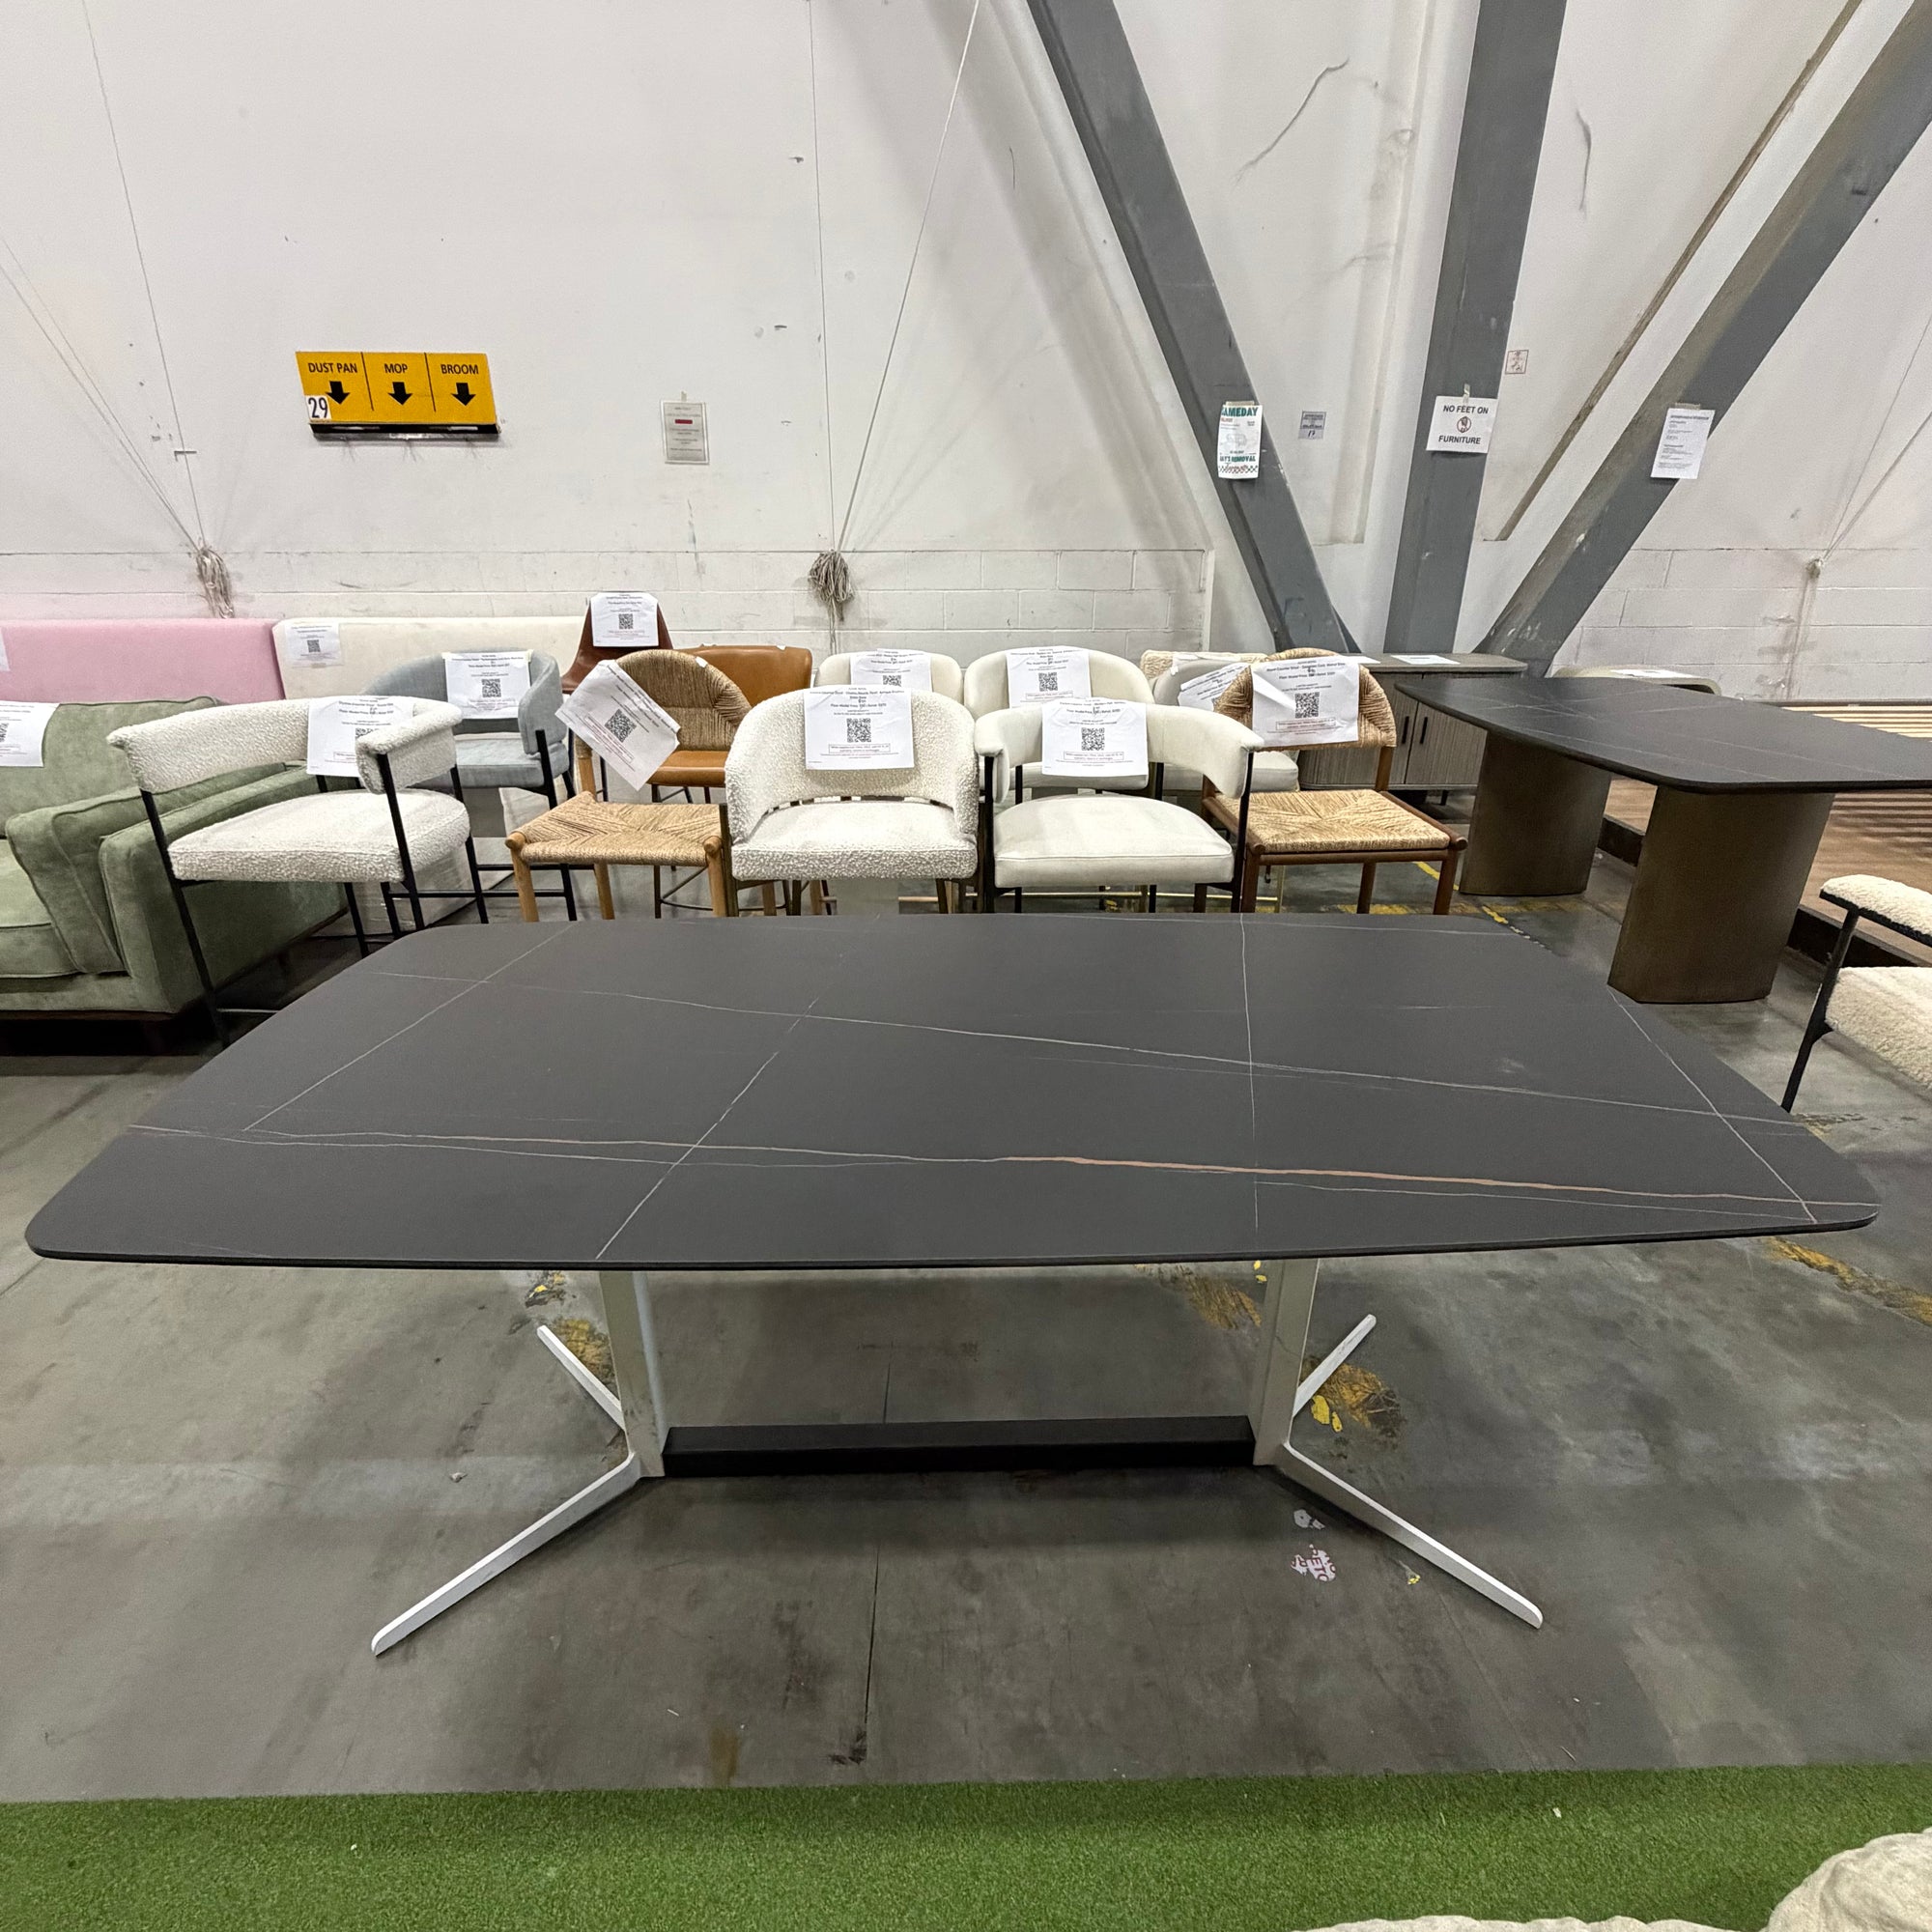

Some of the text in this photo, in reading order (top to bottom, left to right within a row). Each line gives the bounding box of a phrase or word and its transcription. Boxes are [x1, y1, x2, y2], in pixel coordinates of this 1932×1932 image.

[308, 362, 357, 373] DUST PAN
[384, 363, 408, 374] MOP
[440, 364, 479, 375] BROOM
[308, 397, 328, 418] 29
[1438, 435, 1481, 444] FURNITURE
